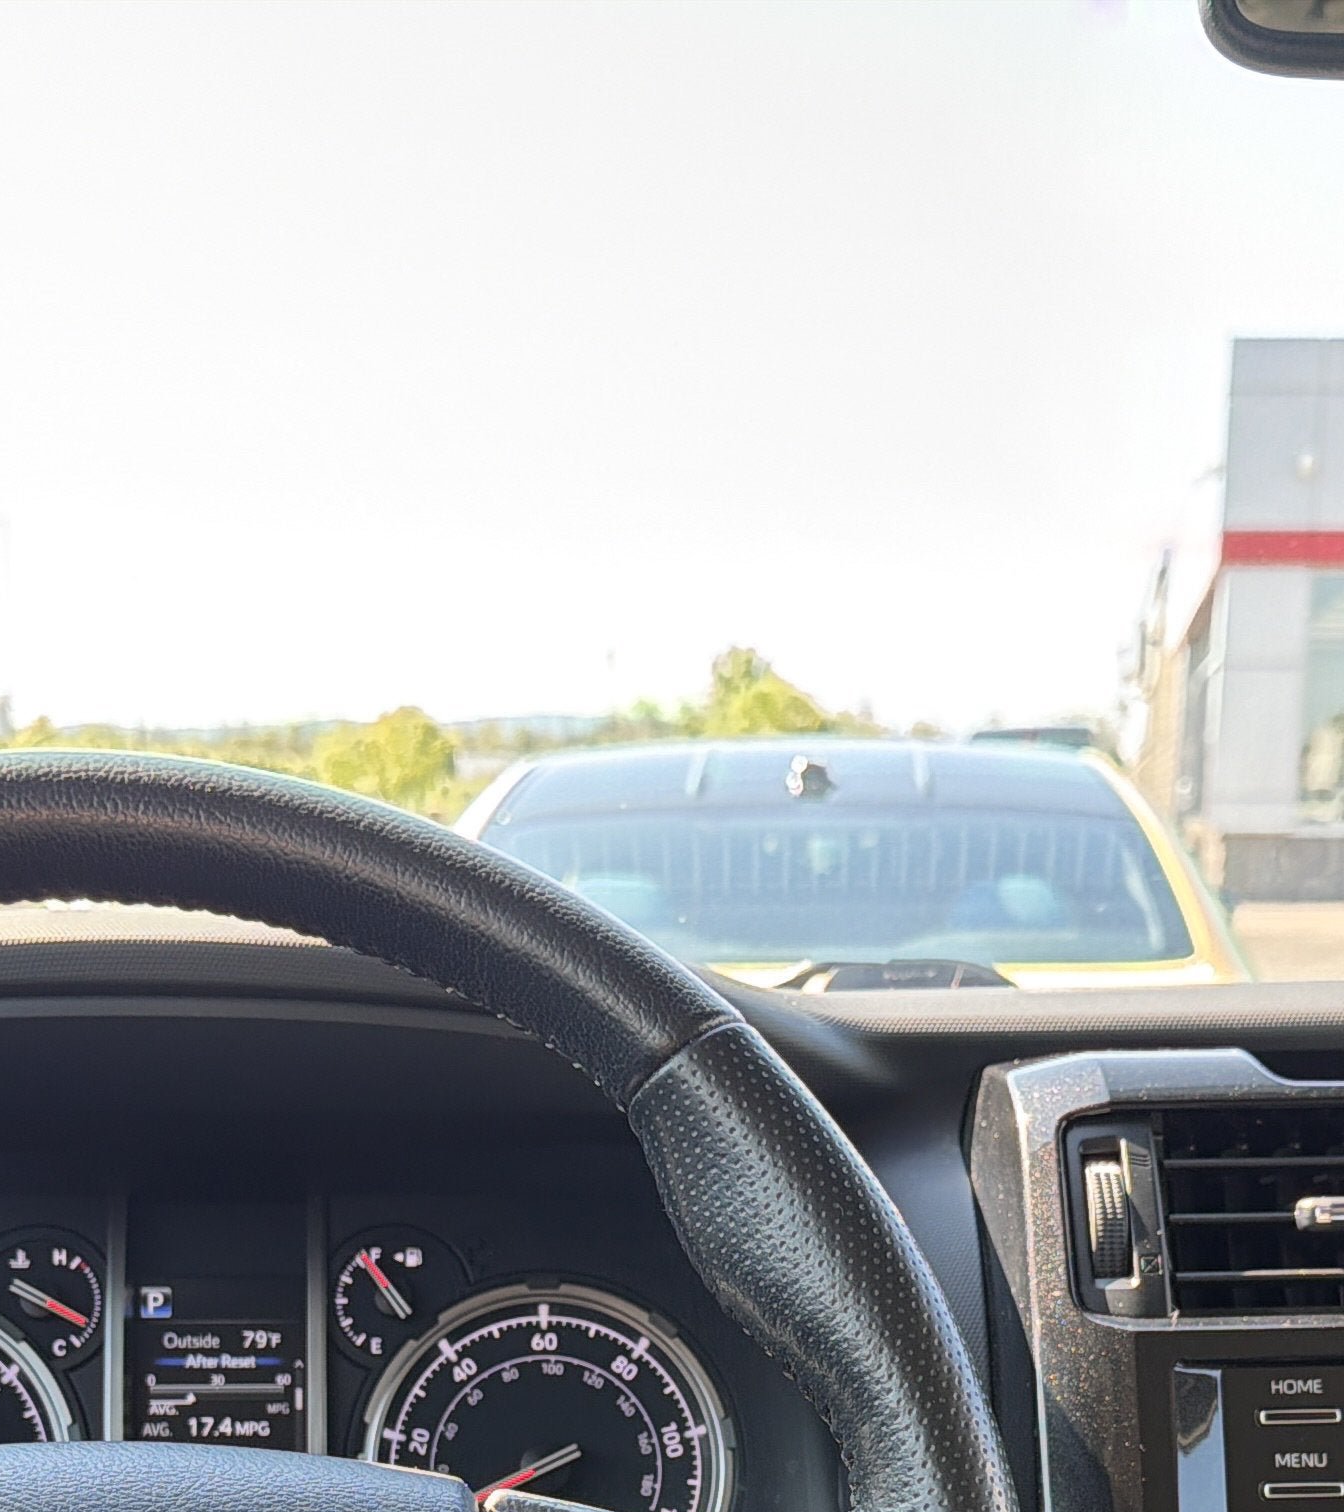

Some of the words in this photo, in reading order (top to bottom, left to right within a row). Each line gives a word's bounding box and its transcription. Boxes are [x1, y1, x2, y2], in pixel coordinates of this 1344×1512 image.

[52, 1249, 68, 1267] H
[51, 1340, 67, 1357] C
[163, 1332, 220, 1350] Outside
[370, 1337, 383, 1355] E
[531, 1333, 558, 1352] 60
[184, 1354, 218, 1370] After
[221, 1354, 256, 1369] Reset
[453, 1357, 478, 1383] 40
[541, 1363, 564, 1377] 100
[610, 1354, 640, 1381] 80
[210, 1374, 226, 1387] 30
[582, 1369, 605, 1390] 120
[1271, 1379, 1323, 1394] HOME
[267, 1403, 290, 1415] MPG
[616, 1395, 636, 1418] 140
[188, 1416, 232, 1437] 17.4
[235, 1421, 271, 1437] MPG
[409, 1427, 430, 1456] 20
[660, 1421, 683, 1458] 100
[1275, 1453, 1327, 1468] MENU
